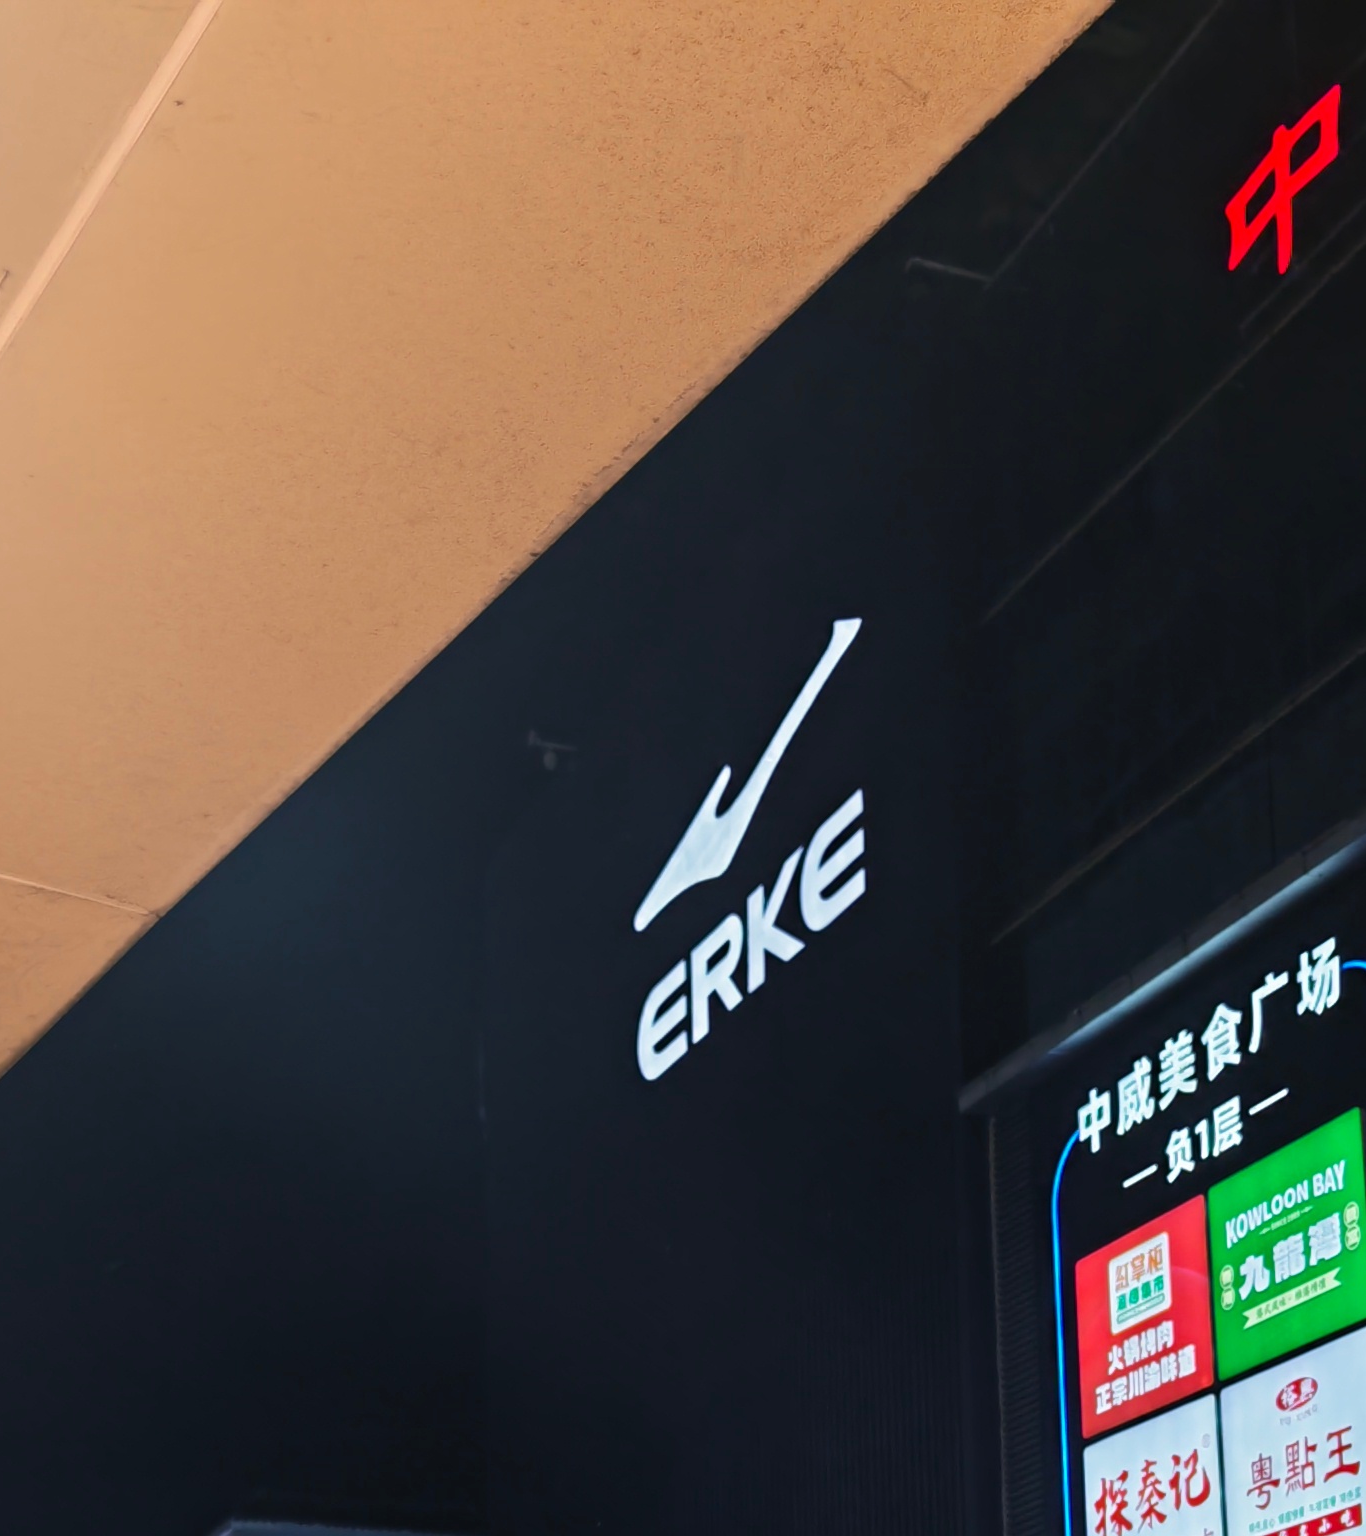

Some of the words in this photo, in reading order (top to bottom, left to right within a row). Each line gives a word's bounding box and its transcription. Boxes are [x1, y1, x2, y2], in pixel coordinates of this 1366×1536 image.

[637, 788, 866, 1081] ERKE
[1076, 937, 1341, 1154] 中威美食广场
[1165, 1095, 1244, 1184] 负1层
[1224, 1179, 1310, 1250] KOWLOON
[1312, 1159, 1347, 1198] BAY
